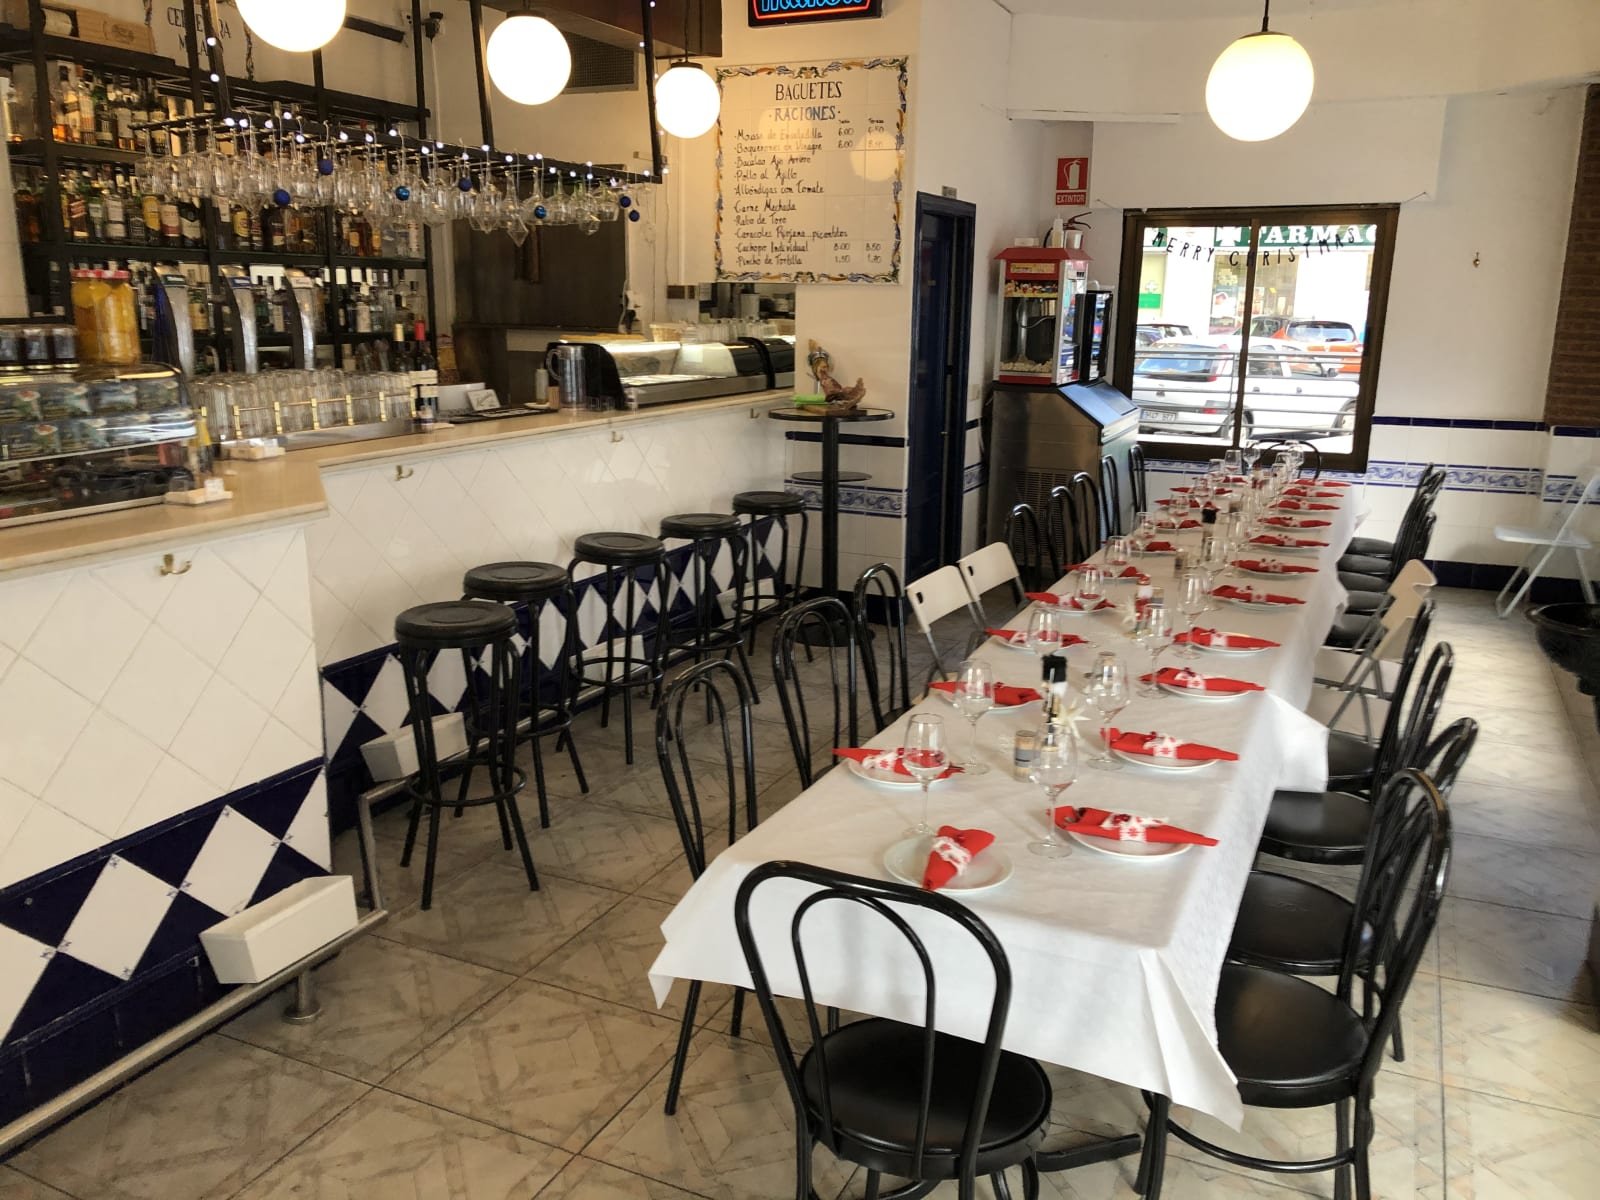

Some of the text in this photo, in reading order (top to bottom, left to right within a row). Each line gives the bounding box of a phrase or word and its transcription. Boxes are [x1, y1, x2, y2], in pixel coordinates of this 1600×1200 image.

[775, 81, 843, 101] BAGUETES
[774, 105, 836, 122] RACIONES
[736, 155, 766, 168] Bacalao
[736, 168, 797, 186] Pollo al Ajillo
[796, 179, 824, 194] Tomate
[734, 199, 797, 213] Carne Mechada
[1056, 194, 1084, 204] EXTINTOR
[736, 212, 786, 226] Rabo de Toro
[770, 240, 808, 253] Individual
[1152, 231, 1215, 263] MERRY
[764, 254, 774, 265] de
[774, 253, 803, 266] Tortilla
